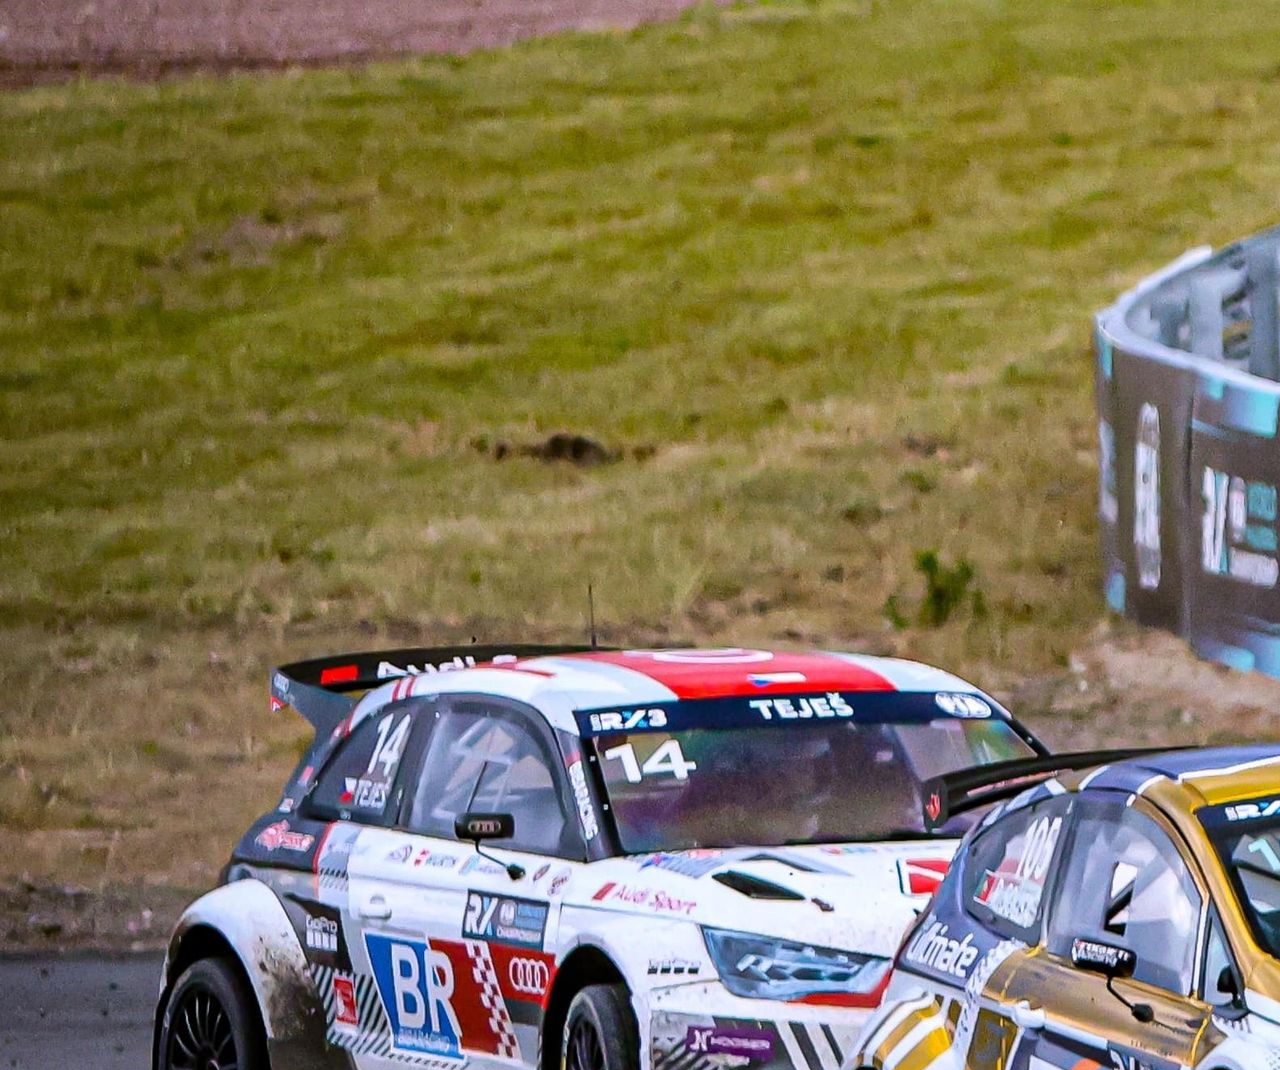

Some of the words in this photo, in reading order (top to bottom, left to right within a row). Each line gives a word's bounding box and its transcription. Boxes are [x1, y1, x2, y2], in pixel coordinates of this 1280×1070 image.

[749, 692, 854, 720] TEJEŠ
[367, 713, 411, 776] 14
[605, 740, 697, 784] 14
[391, 943, 463, 1038] BR
